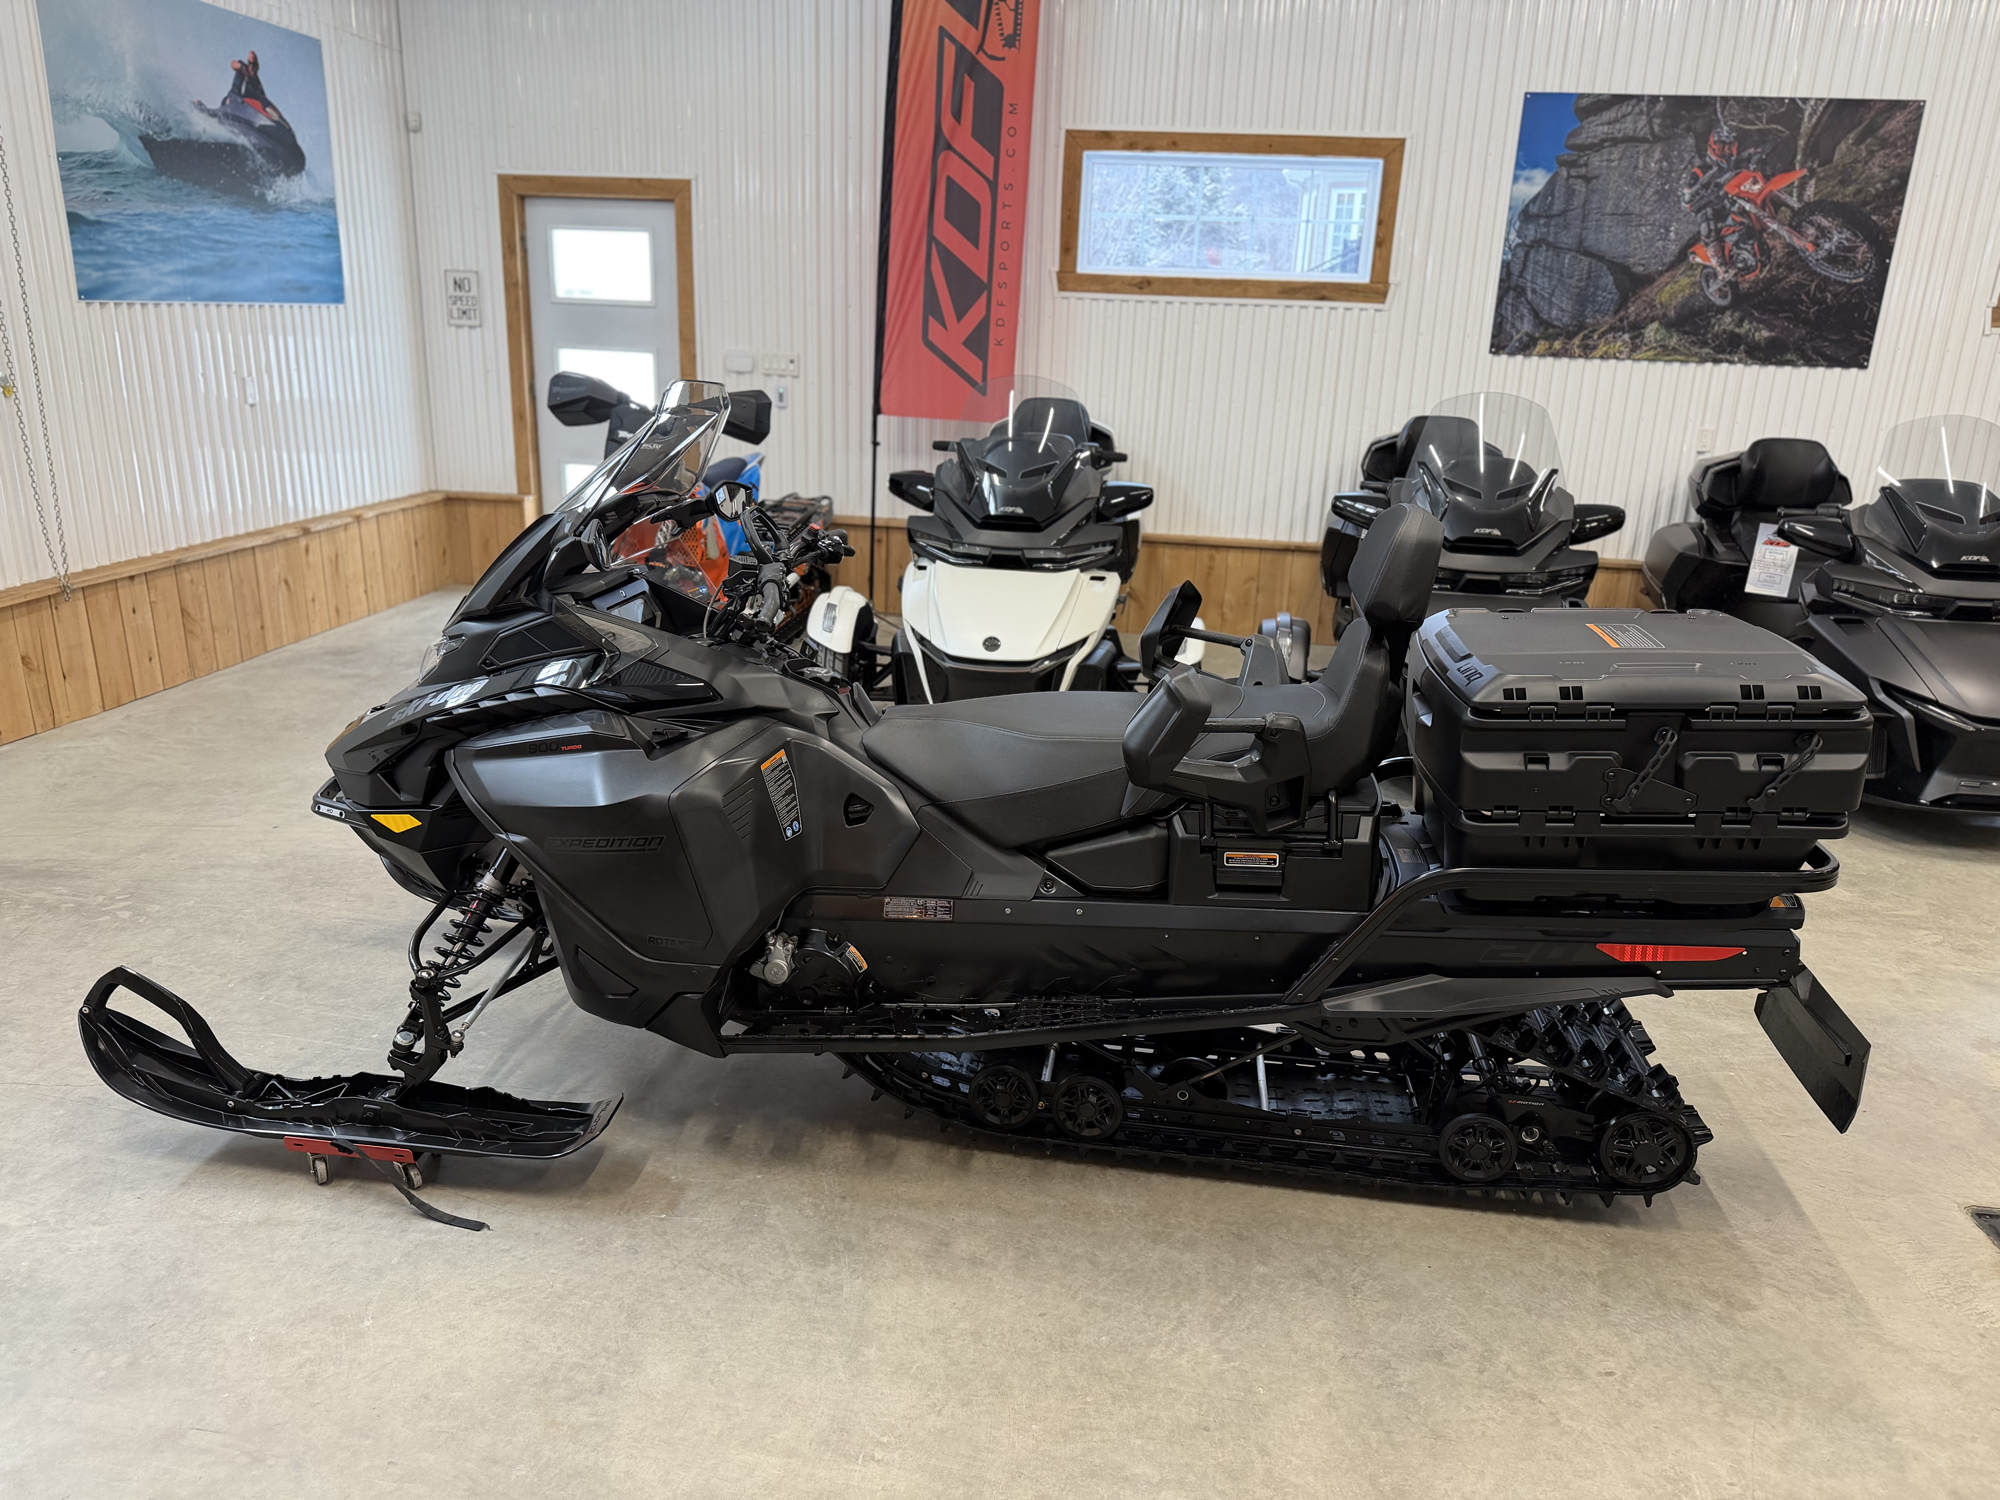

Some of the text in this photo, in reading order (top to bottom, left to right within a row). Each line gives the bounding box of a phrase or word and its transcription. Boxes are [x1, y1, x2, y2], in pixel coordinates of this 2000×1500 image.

[994, 103, 1019, 347] KDFSPORTS.COM
[453, 276, 471, 293] NO
[528, 742, 558, 753] 900
[546, 836, 664, 849] EXPEDITION
